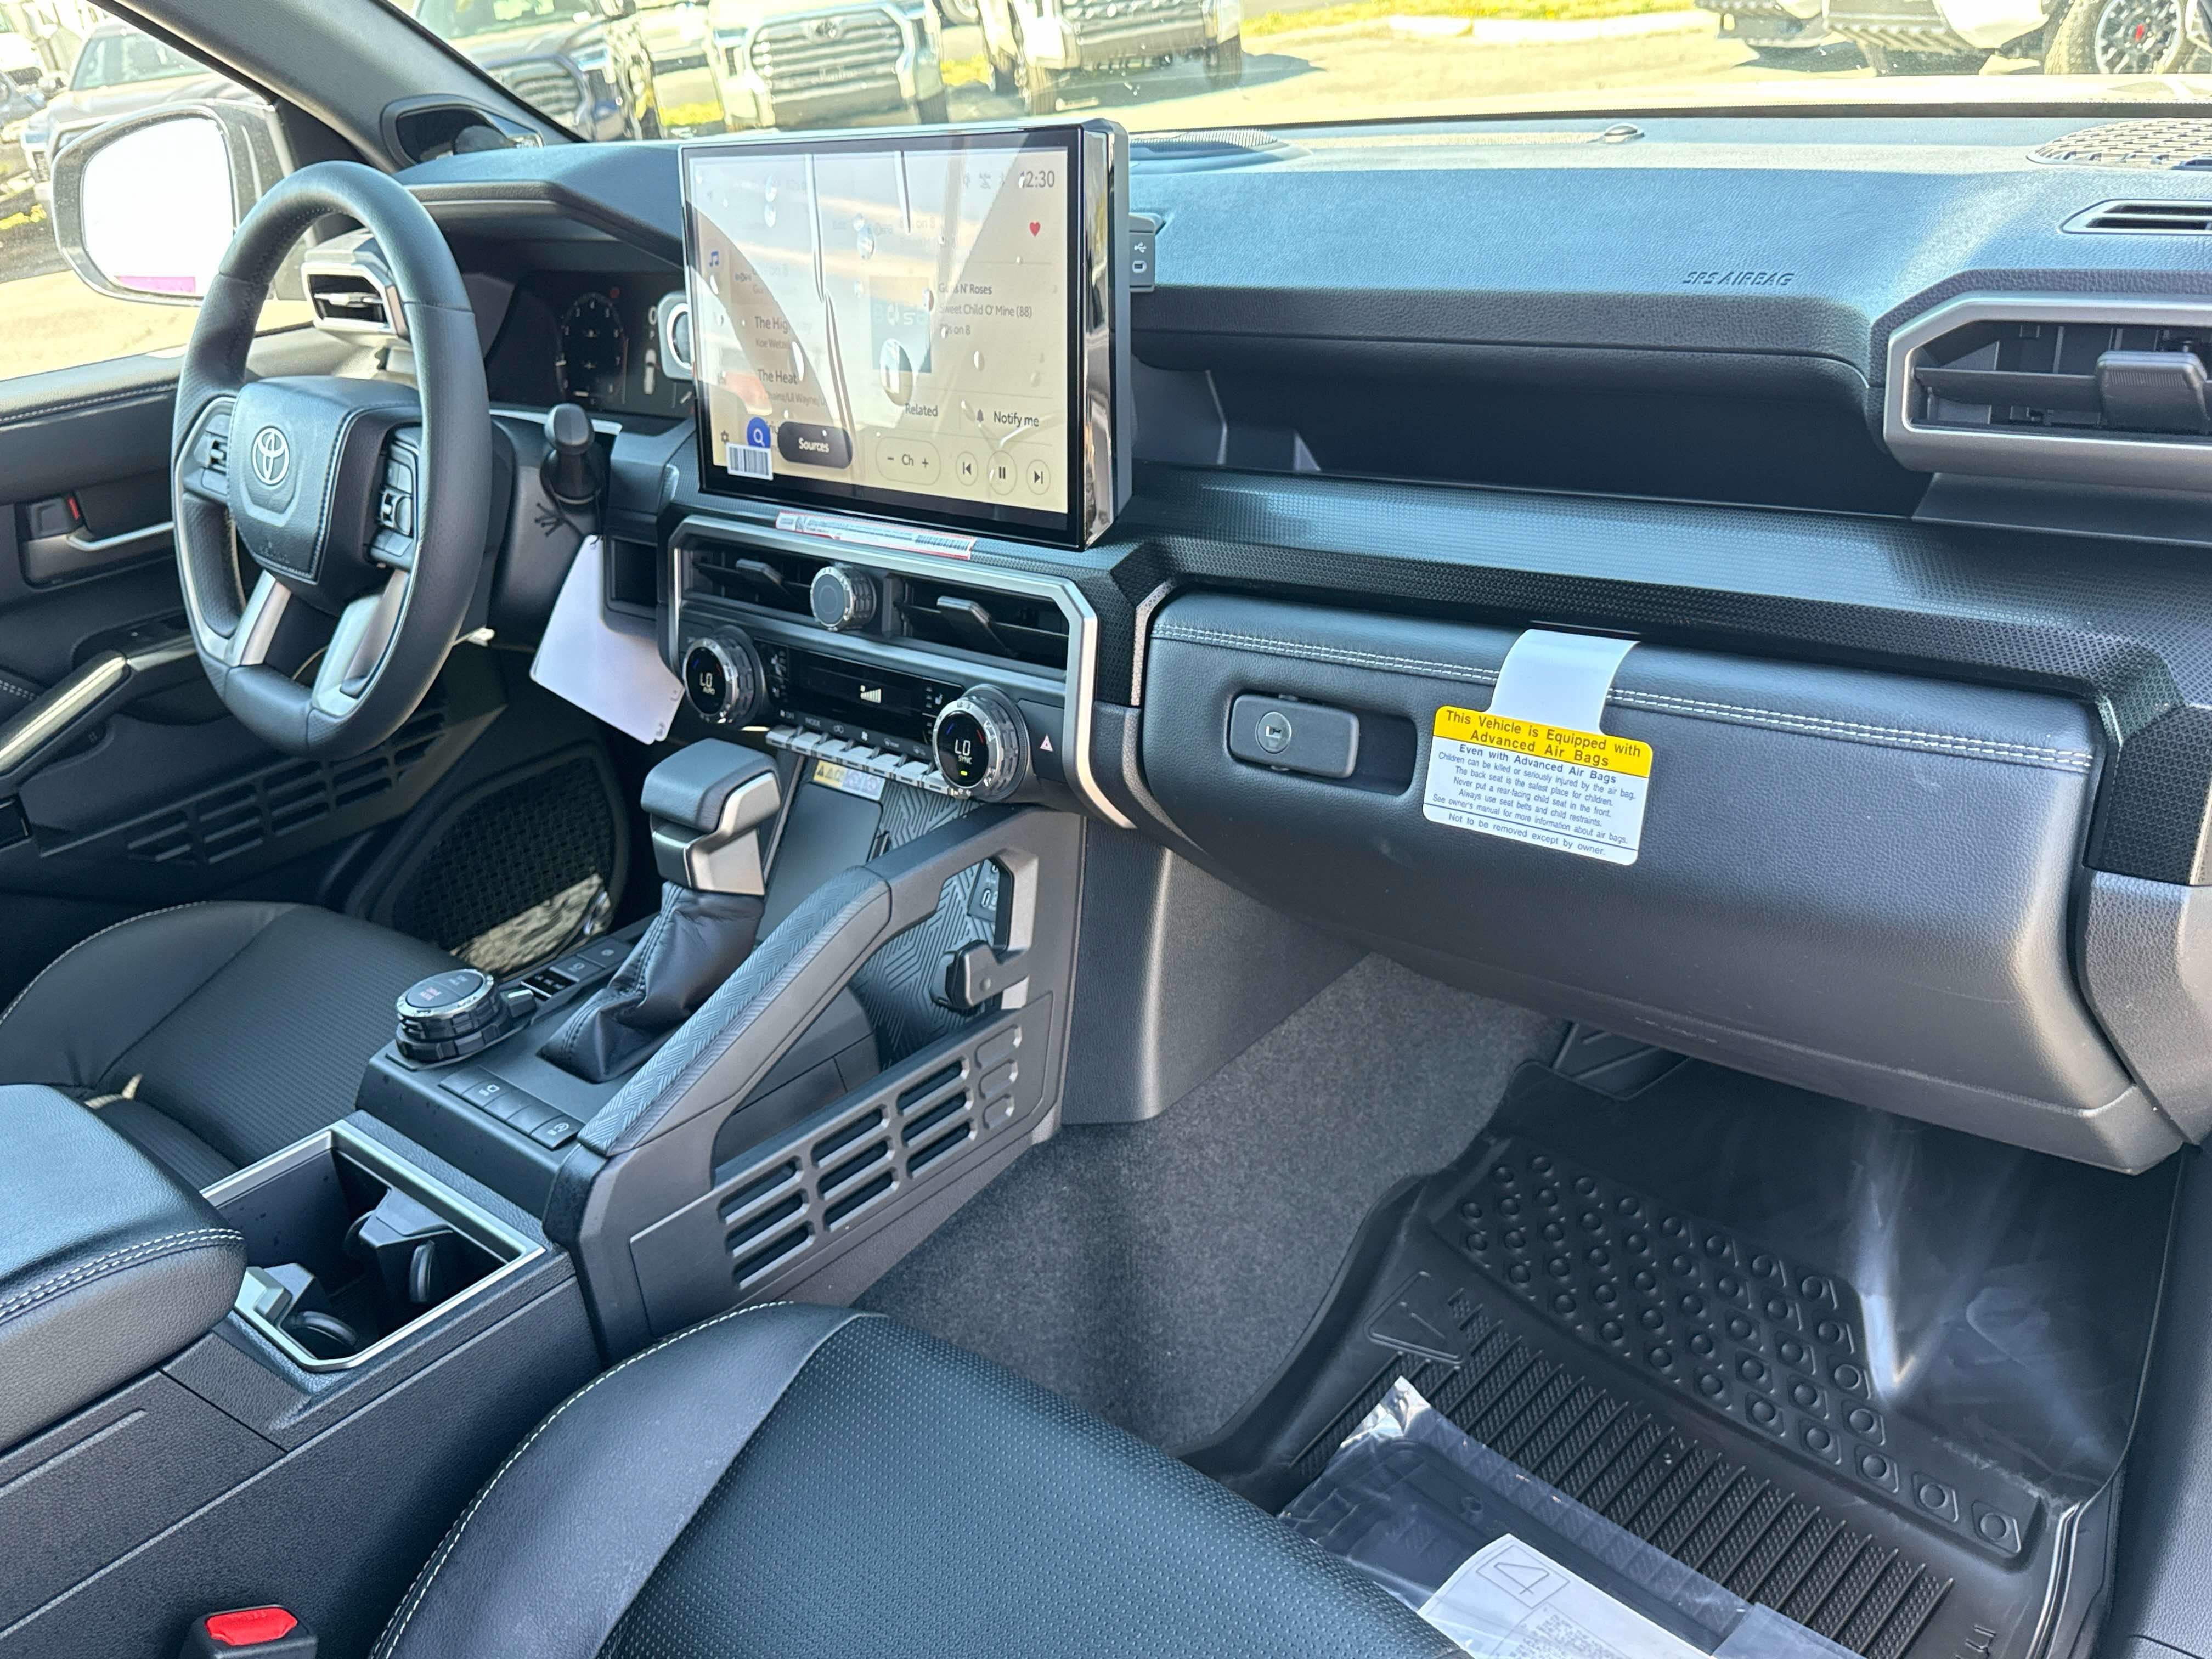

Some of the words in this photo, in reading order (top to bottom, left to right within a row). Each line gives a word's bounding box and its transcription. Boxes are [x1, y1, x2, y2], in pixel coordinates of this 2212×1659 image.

[1683, 272, 1719, 285] SRS
[1718, 272, 1795, 285] AIRBAG
[939, 282, 959, 294] Gs
[969, 283, 992, 295] Roses
[939, 304, 962, 314] Sweet
[963, 303, 984, 315] Child
[996, 304, 1015, 317] Mine
[1016, 306, 1032, 318] (88)
[754, 316, 772, 330] The
[954, 326, 964, 334] on
[966, 324, 971, 335] 8
[758, 369, 774, 382] The
[775, 370, 798, 384] Heat
[905, 403, 938, 417] Related
[993, 411, 1023, 427] Notify
[1024, 416, 1039, 427] me
[798, 437, 830, 453] Sources
[901, 454, 914, 466] Ch
[1446, 710, 1471, 724] This
[1479, 716, 1522, 734] Vehicle
[1528, 725, 1539, 737] is
[1546, 729, 1607, 750] Equipped
[1615, 743, 1641, 757] with
[954, 739, 971, 756] LO
[1470, 730, 1537, 753] Advanced
[1544, 744, 1565, 757] Air
[1574, 749, 1609, 766] Bags
[958, 756, 973, 765] SYNC
[1459, 744, 1483, 756] Even
[1489, 752, 1509, 761] with
[1514, 755, 1564, 772] Advanced
[1568, 766, 1585, 776] Air
[1590, 770, 1617, 784] Bags
[1438, 752, 1465, 764] Children
[1482, 760, 1491, 769] be
[1494, 763, 1511, 773] killed
[1523, 770, 1553, 783] seriously
[1555, 776, 1579, 787] injured
[1581, 781, 1590, 791] by
[1593, 783, 1605, 793] the
[1620, 788, 1635, 800] bag.
[1455, 765, 1468, 775] The
[1471, 769, 1486, 779] back
[1489, 774, 1504, 782] seat
[1506, 776, 1512, 785] is
[1515, 778, 1526, 787] the
[1528, 782, 1549, 792] safest
[1550, 787, 1569, 797] place
[1572, 790, 1582, 799] for
[1584, 794, 1613, 806] children.
[1454, 776, 1473, 787] Never
[1497, 787, 1531, 802] rear-facing
[1534, 794, 1550, 804] child
[1552, 799, 1567, 808] seat
[1580, 804, 1591, 812] the
[1594, 806, 1611, 817] front.
[1458, 789, 1482, 801] Always
[1499, 799, 1514, 807] seat
[1516, 801, 1532, 811] belts
[1535, 806, 1548, 815] and
[1551, 809, 1567, 819] child
[1570, 814, 1602, 827] restraints.
[1433, 793, 1446, 803] See
[1448, 799, 1474, 809] owner's
[1476, 805, 1500, 815] manual
[1503, 809, 1513, 817] for
[1515, 813, 1532, 822] more
[1534, 816, 1571, 831] information
[1574, 826, 1594, 836] about
[1609, 832, 1628, 844] bags.
[1449, 813, 1463, 823] Not
[1479, 820, 1489, 828] be
[1493, 825, 1528, 837] removed
[1532, 833, 1559, 844] except
[1563, 838, 1573, 849] by
[1577, 844, 1606, 855] owner.
